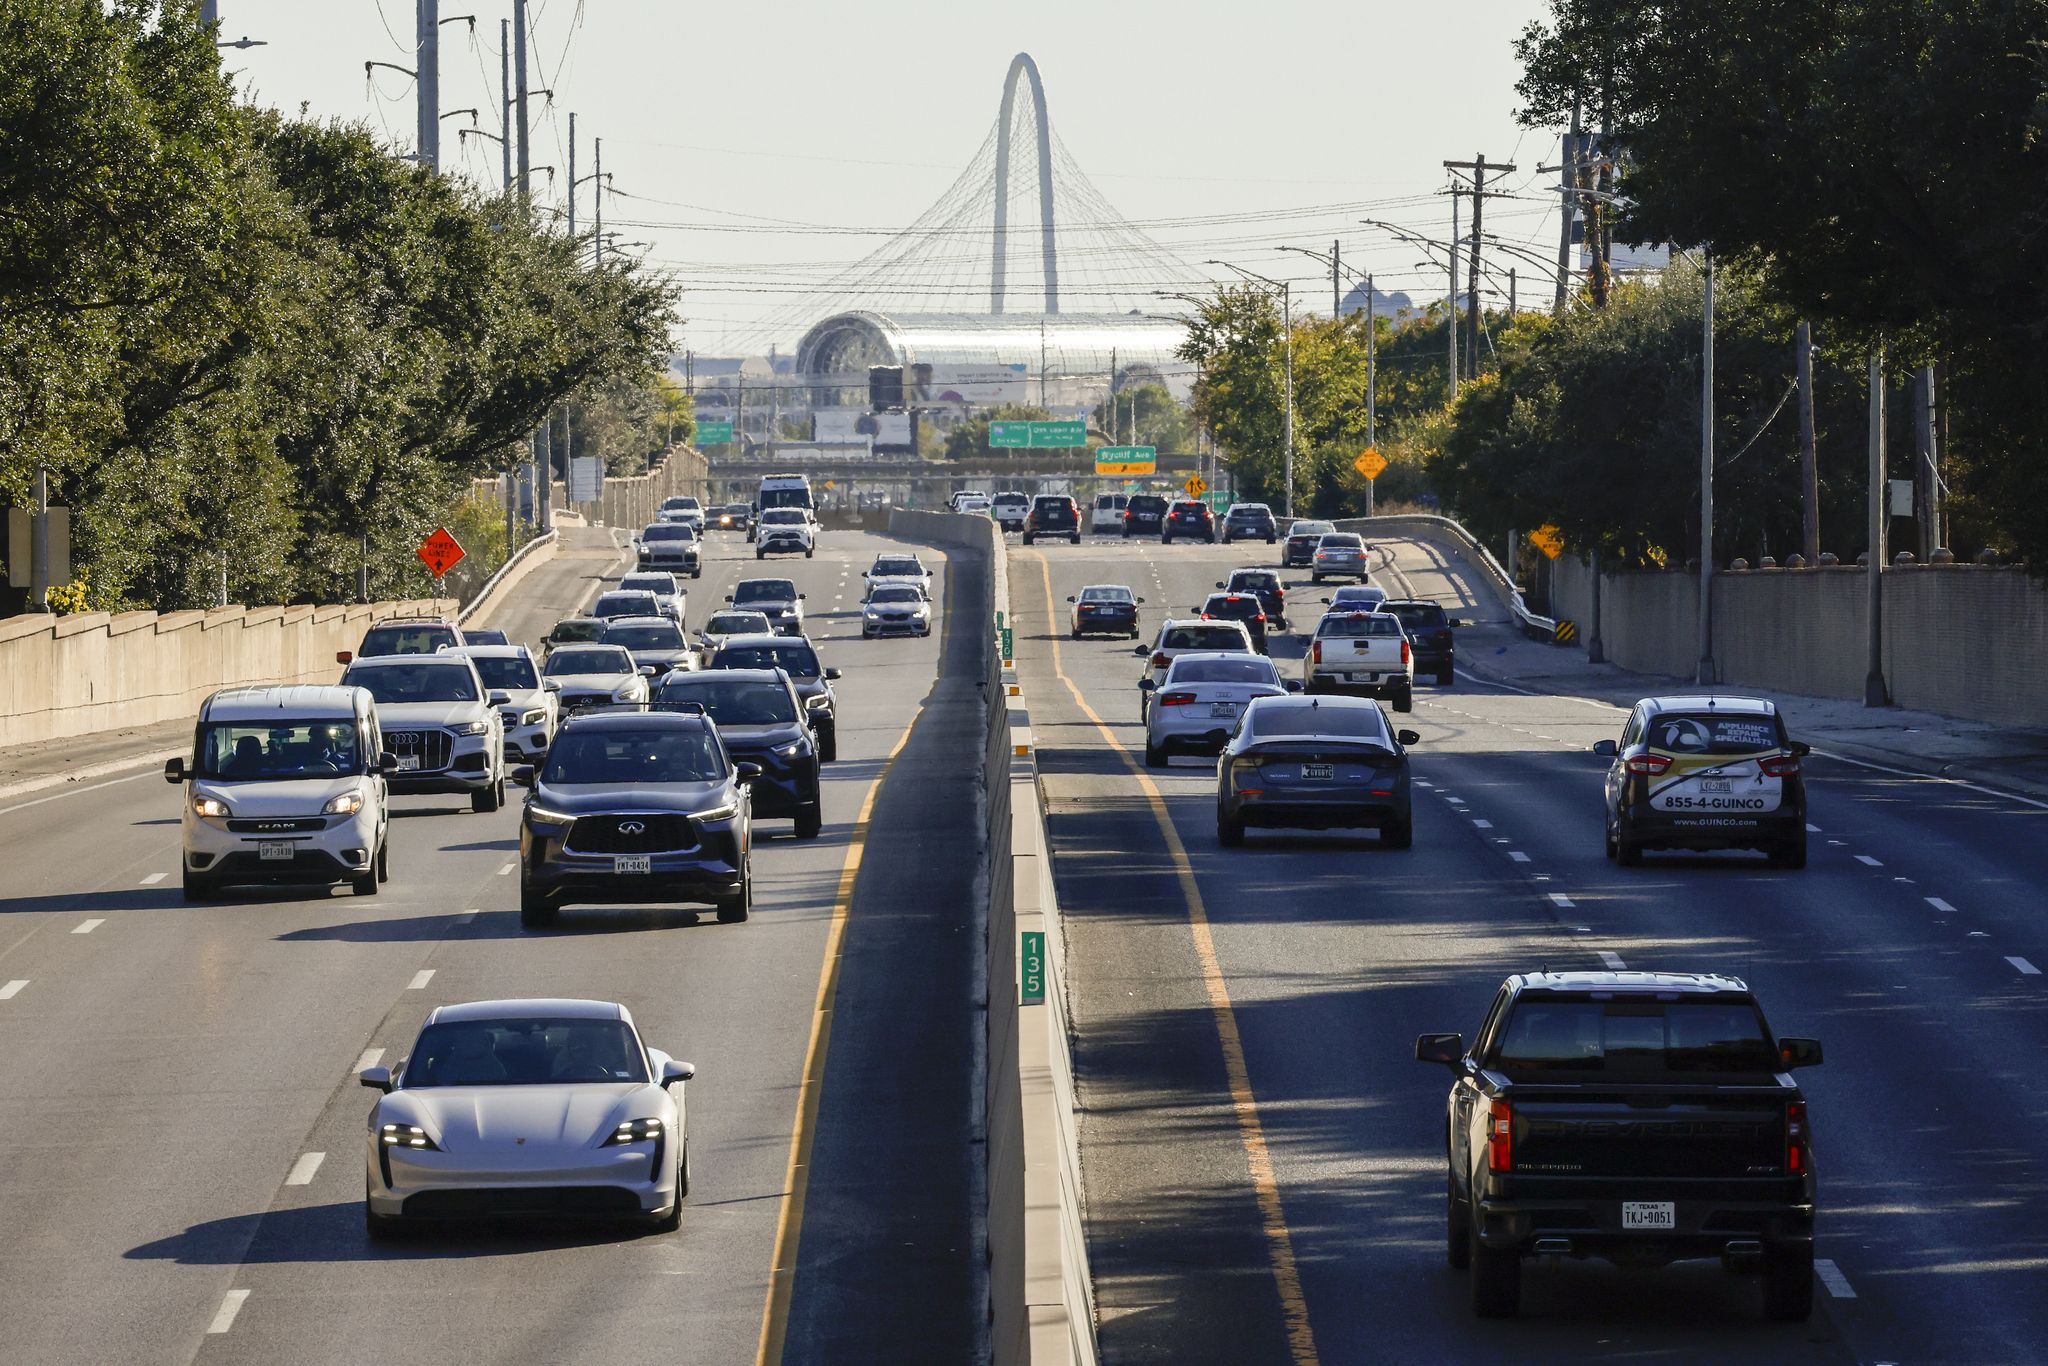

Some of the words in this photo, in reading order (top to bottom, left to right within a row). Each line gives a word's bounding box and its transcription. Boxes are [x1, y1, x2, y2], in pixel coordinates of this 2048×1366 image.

[1135, 451, 1150, 459] Ave
[1717, 722, 1769, 733] APPLIANCE
[1727, 729, 1760, 738] REPAIR
[1714, 735, 1773, 746] SPECIALISTS
[1665, 797, 1765, 809] 855-4-GUINCO
[1673, 818, 1758, 827] www.GUINCO.com
[1027, 937, 1041, 993] 135
[1625, 1211, 1672, 1224] TKJ-9051
